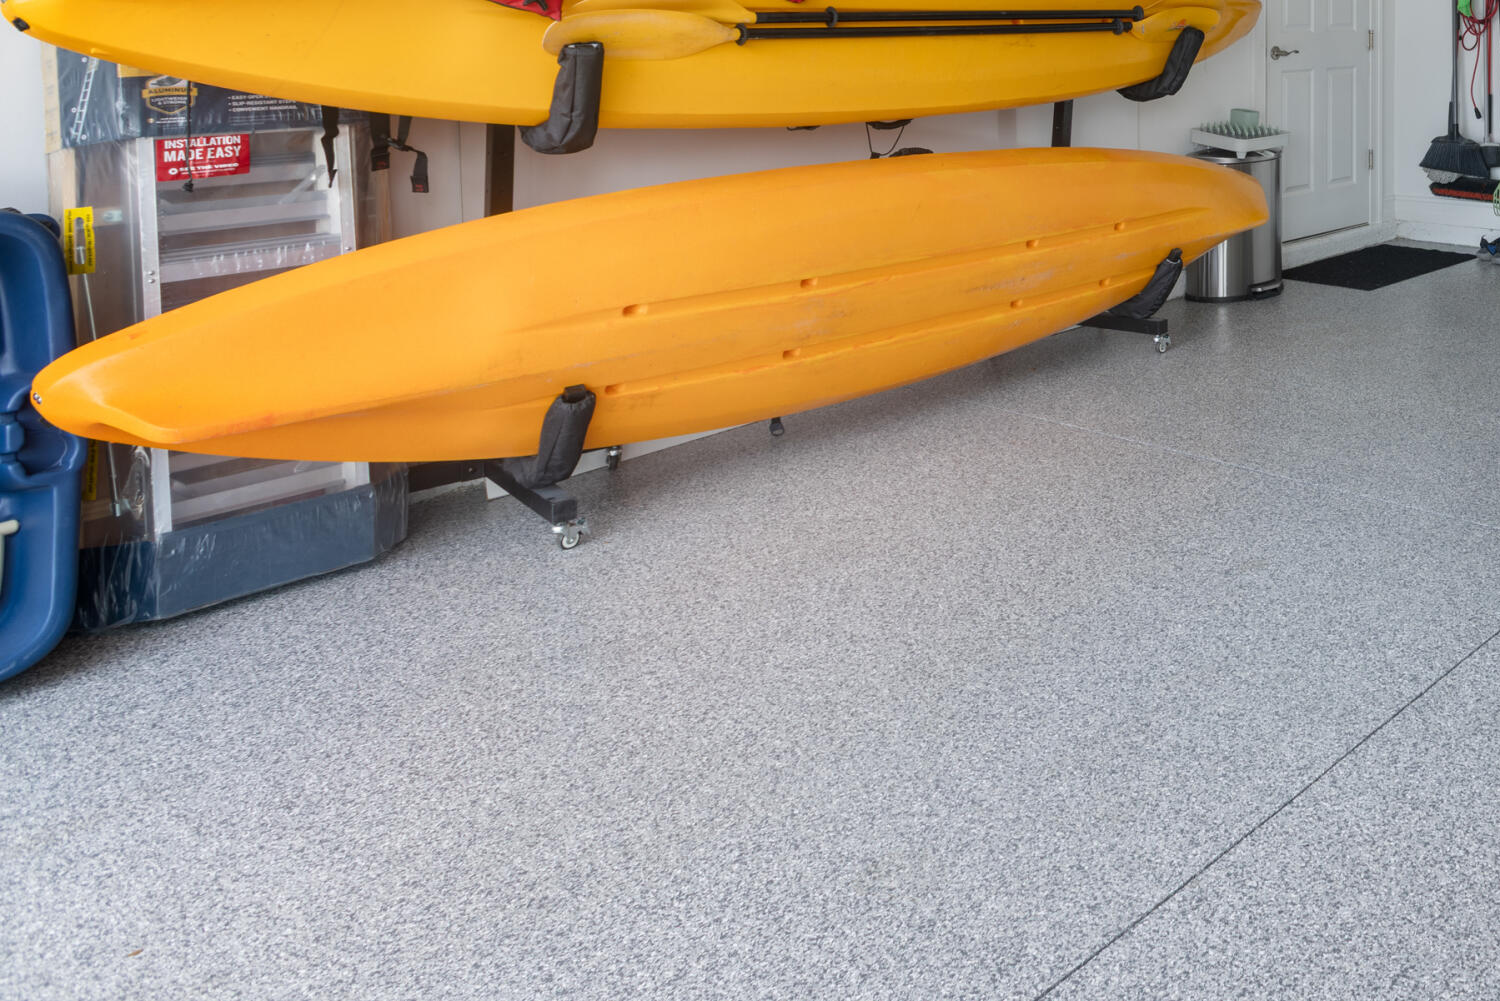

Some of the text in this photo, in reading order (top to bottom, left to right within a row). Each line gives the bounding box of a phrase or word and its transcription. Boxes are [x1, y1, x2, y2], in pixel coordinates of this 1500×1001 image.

[148, 86, 193, 95] ALUMINU
[164, 135, 241, 149] INSTALLATION
[207, 145, 242, 160] EASY
